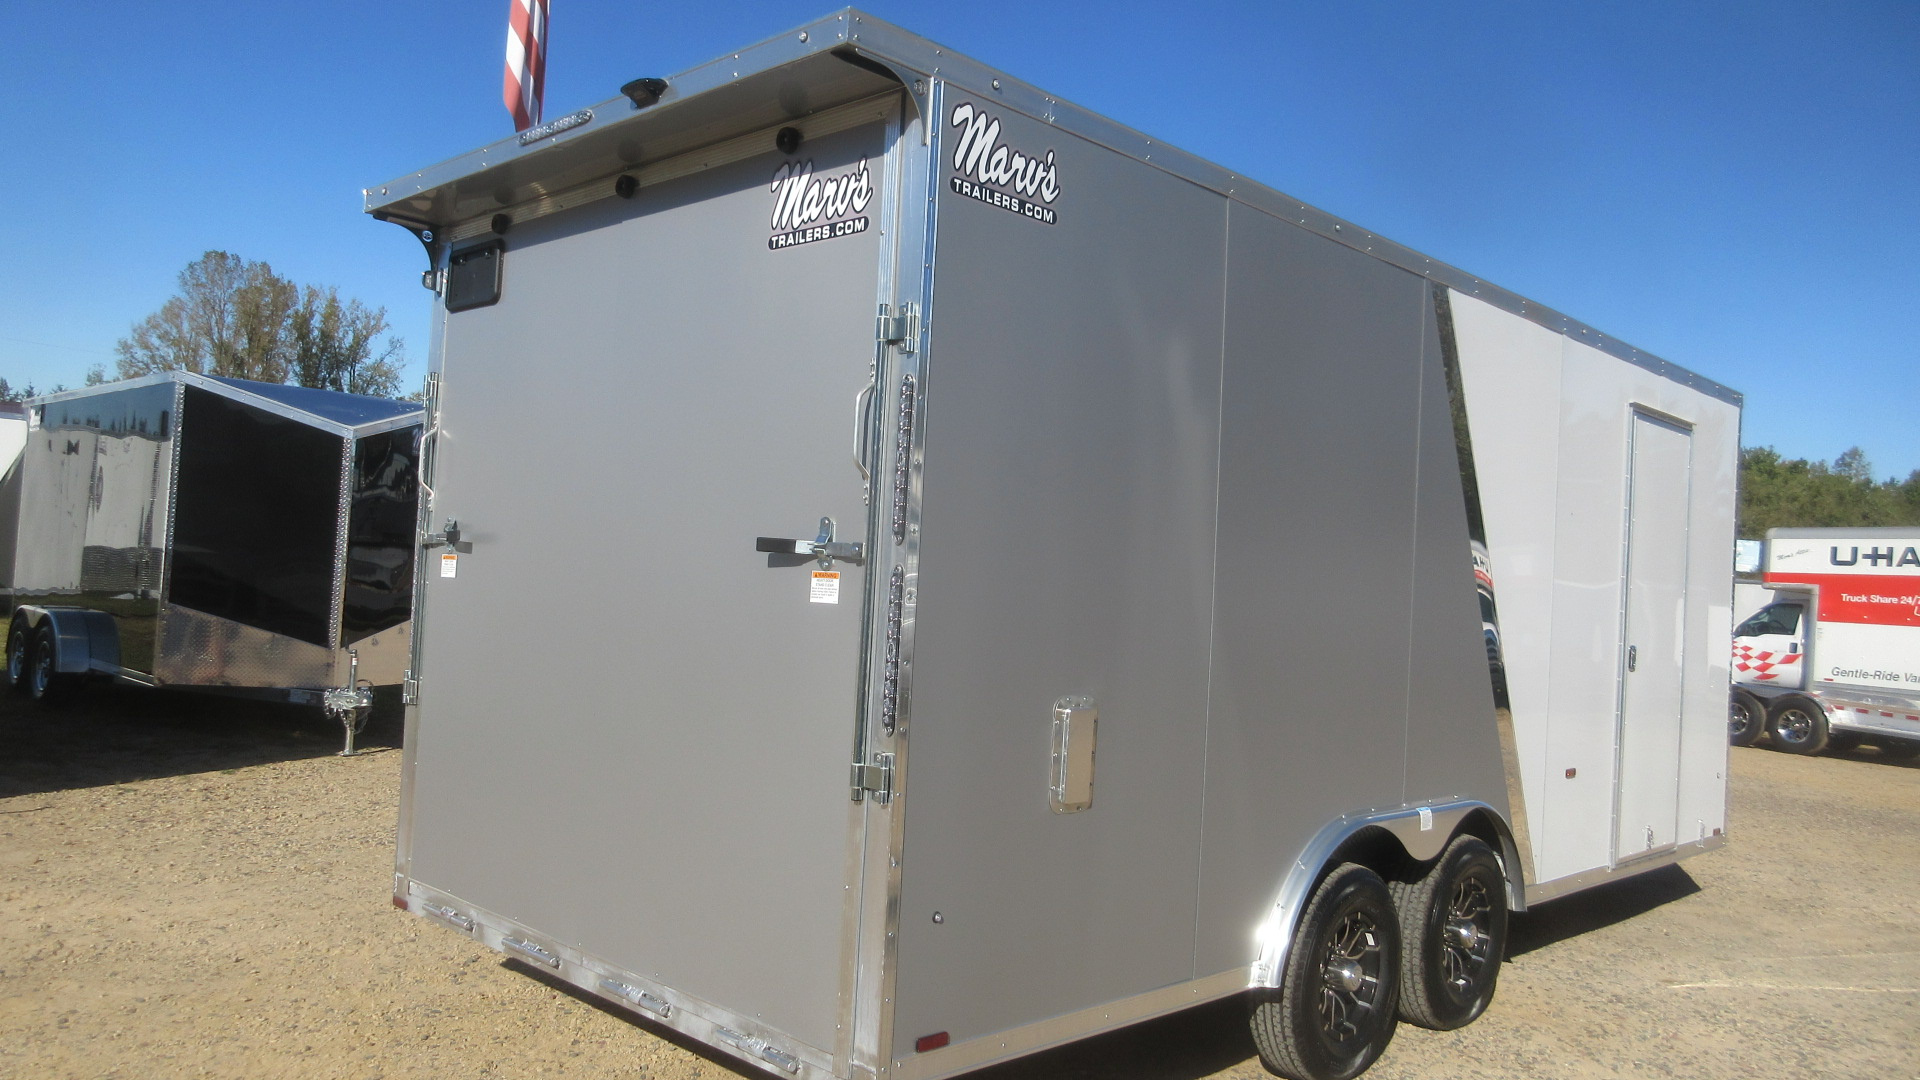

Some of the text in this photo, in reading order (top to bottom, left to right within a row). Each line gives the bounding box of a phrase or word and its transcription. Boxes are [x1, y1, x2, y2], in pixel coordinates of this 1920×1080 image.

[952, 103, 1060, 203] Marv's
[771, 156, 872, 229] Marv's
[952, 178, 1054, 223] TRAILERS.COM
[771, 217, 865, 249] TRAILERS.COM
[1841, 593, 1867, 603] Truck
[1870, 594, 1898, 604] Share
[1831, 666, 1900, 682] Gentle-Ride
